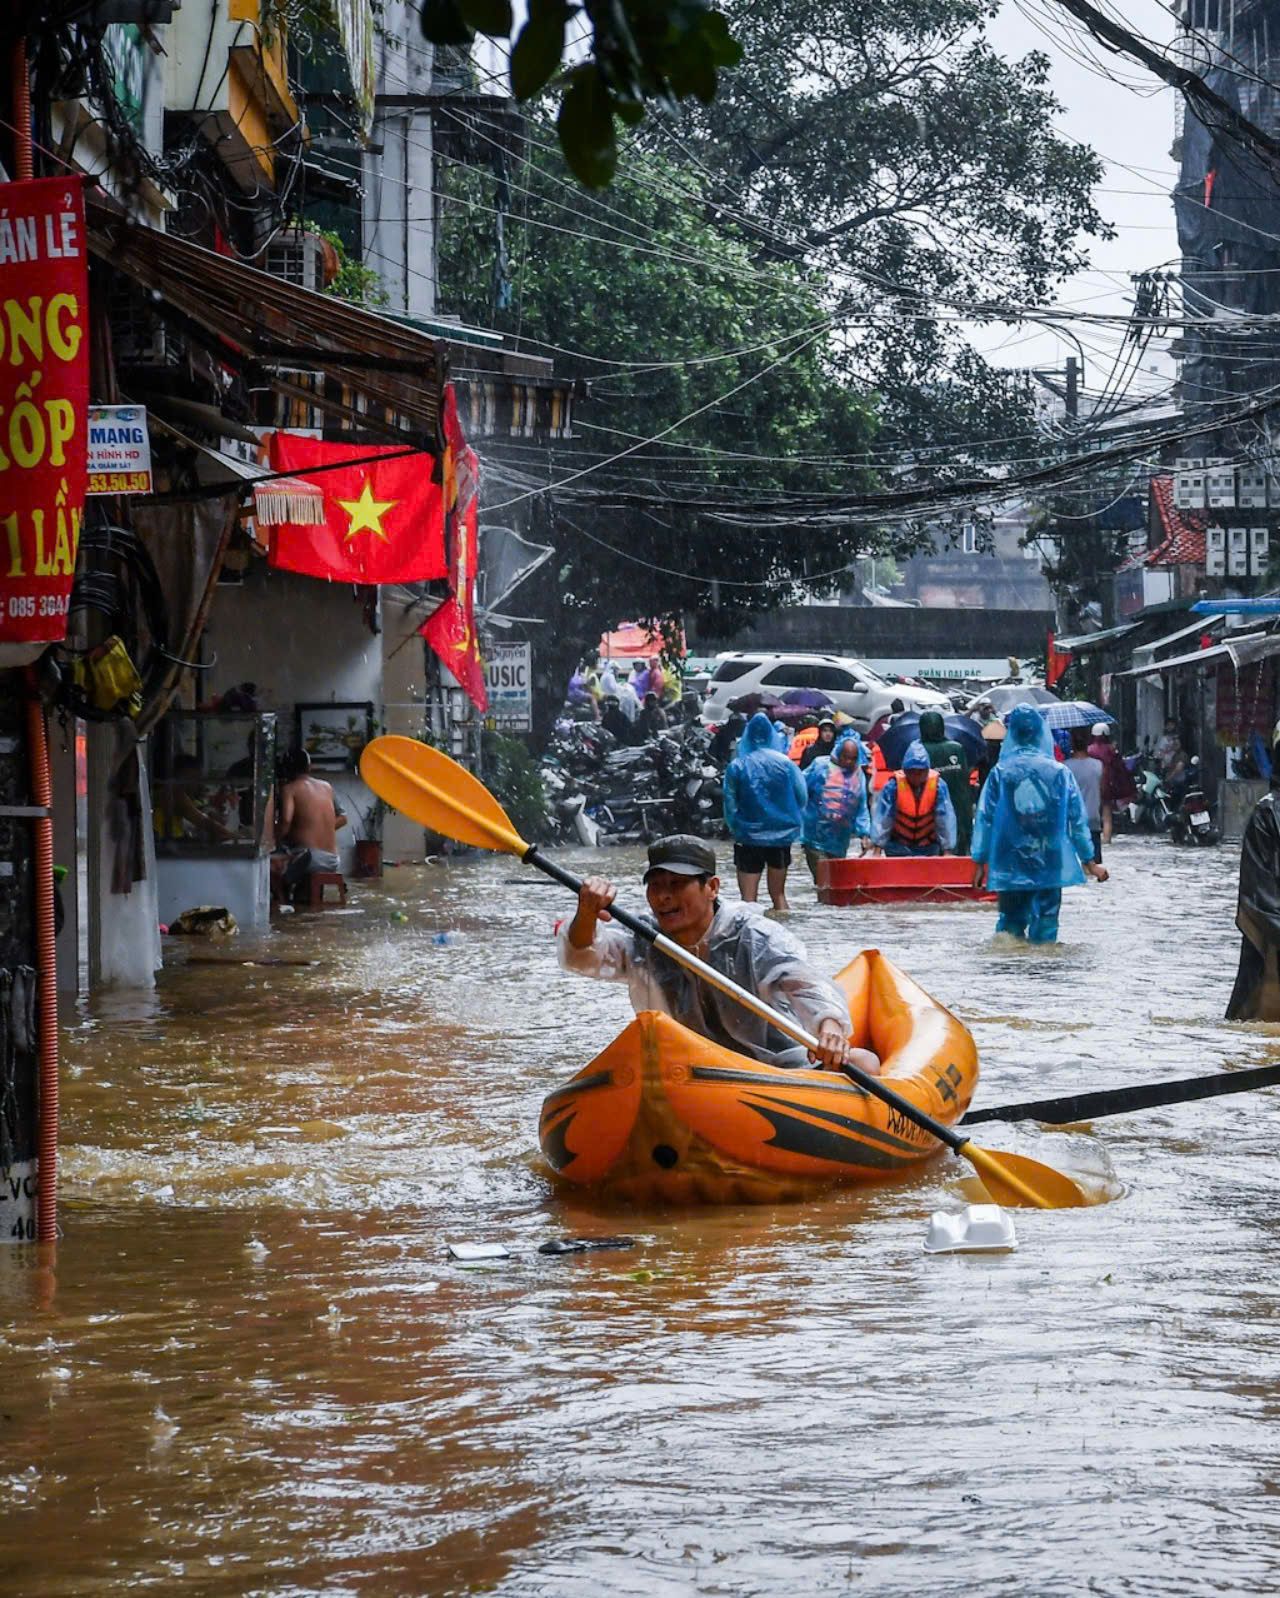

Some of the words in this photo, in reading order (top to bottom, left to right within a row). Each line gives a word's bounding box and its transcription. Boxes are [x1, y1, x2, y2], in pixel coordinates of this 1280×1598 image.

[45, 192, 79, 258] LẺ
[0, 293, 82, 366] NG
[90, 427, 144, 448] MẠNG
[125, 450, 140, 459] HD
[484, 665, 526, 688] USIC
